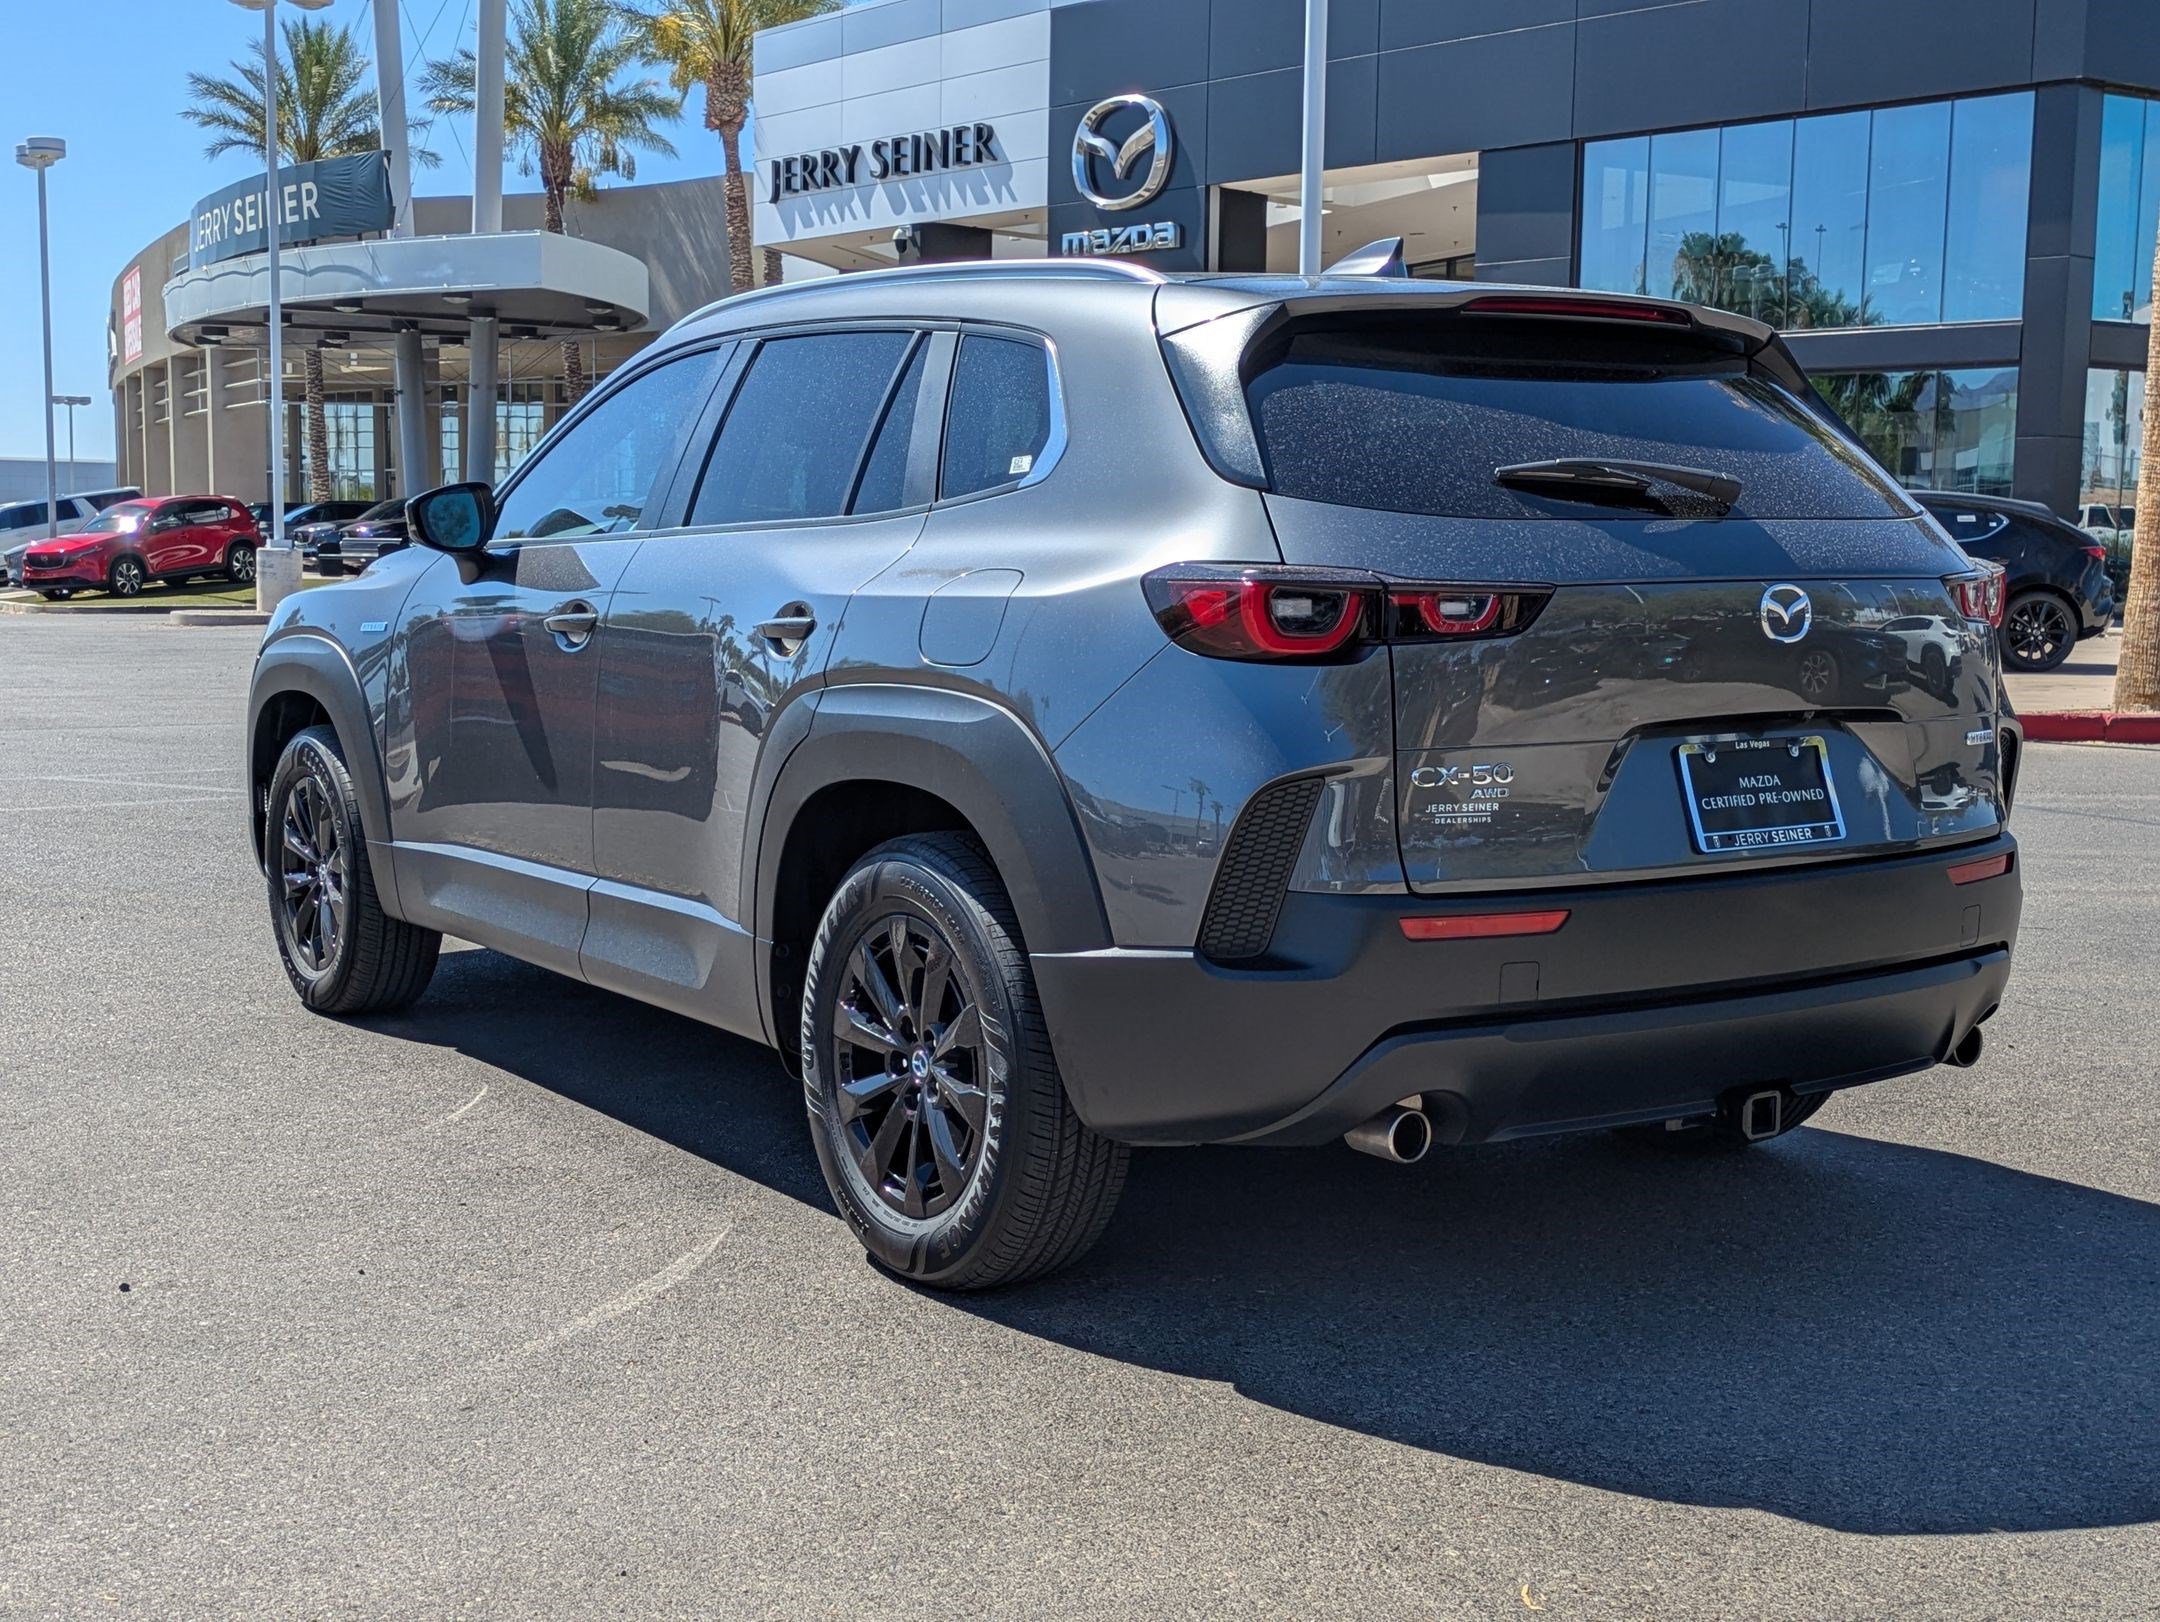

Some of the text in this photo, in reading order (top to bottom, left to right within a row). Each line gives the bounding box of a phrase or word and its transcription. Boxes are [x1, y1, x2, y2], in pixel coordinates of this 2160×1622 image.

[769, 123, 998, 203] JERRY SEINER
[195, 203, 231, 252] JERRY
[1735, 740, 1770, 750] Las Vegas
[1411, 762, 1514, 788] CX-50
[1738, 774, 1782, 789] MAZDA
[1470, 787, 1510, 799] AWD
[1701, 788, 1825, 810] CERTIFIED PRE-OWNED
[1425, 802, 1500, 813] JERRY SEINER
[1434, 816, 1492, 825] DEALERSHIPS
[1734, 827, 1813, 847] JERRY SEINER
